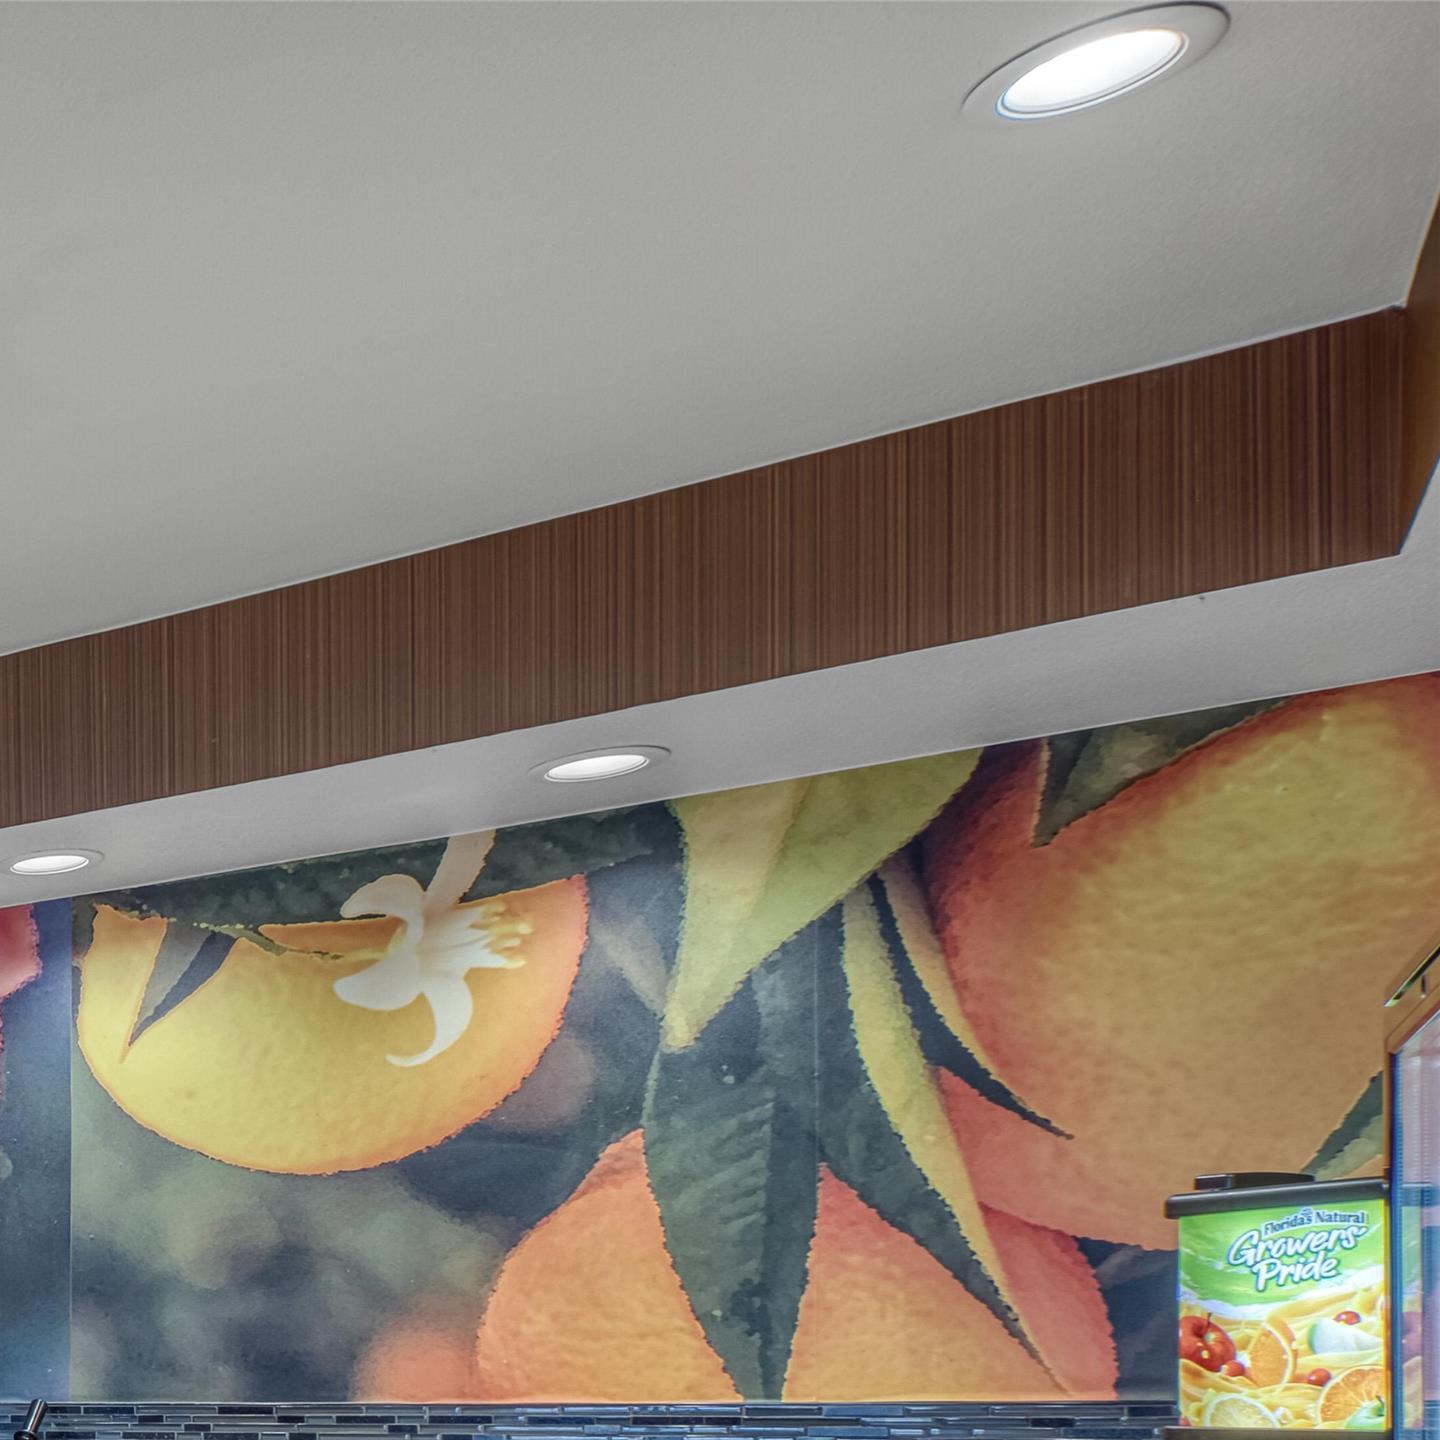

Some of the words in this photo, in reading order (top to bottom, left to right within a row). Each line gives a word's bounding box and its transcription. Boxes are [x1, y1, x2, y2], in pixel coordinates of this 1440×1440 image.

[1263, 1213, 1312, 1236] Florida's
[1315, 1211, 1366, 1224] Natural
[1252, 1252, 1340, 1292] Pride
